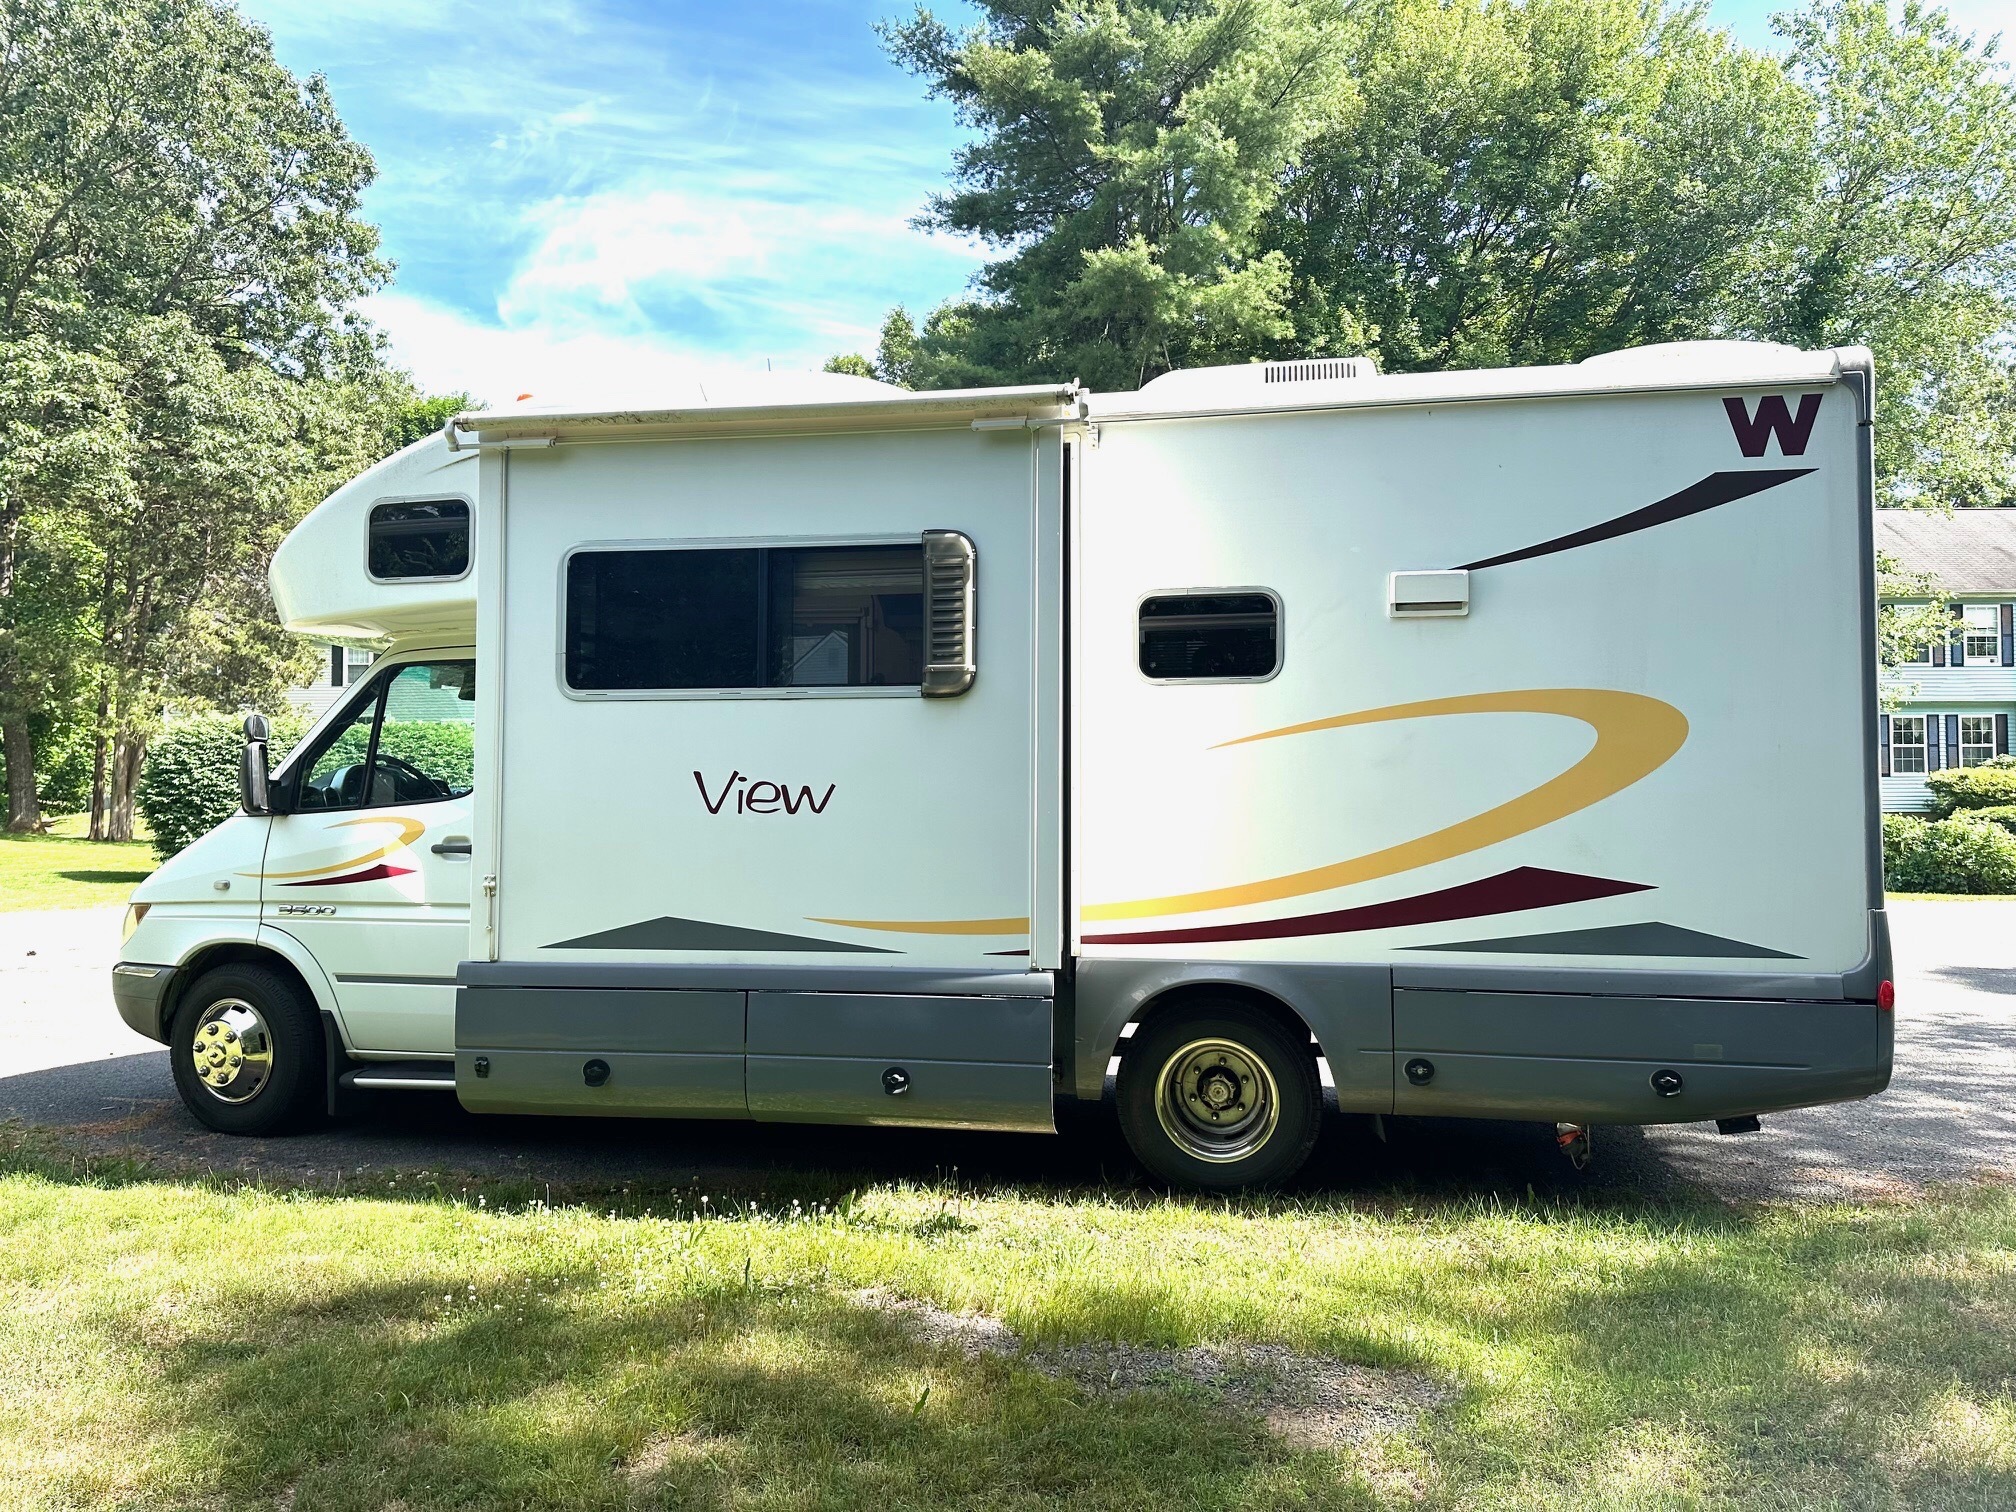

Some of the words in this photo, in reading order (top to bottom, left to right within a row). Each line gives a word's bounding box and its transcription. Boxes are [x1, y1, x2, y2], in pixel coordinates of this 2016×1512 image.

[1722, 393, 1823, 457] W
[693, 770, 836, 815] View
[278, 904, 336, 916] 3500
